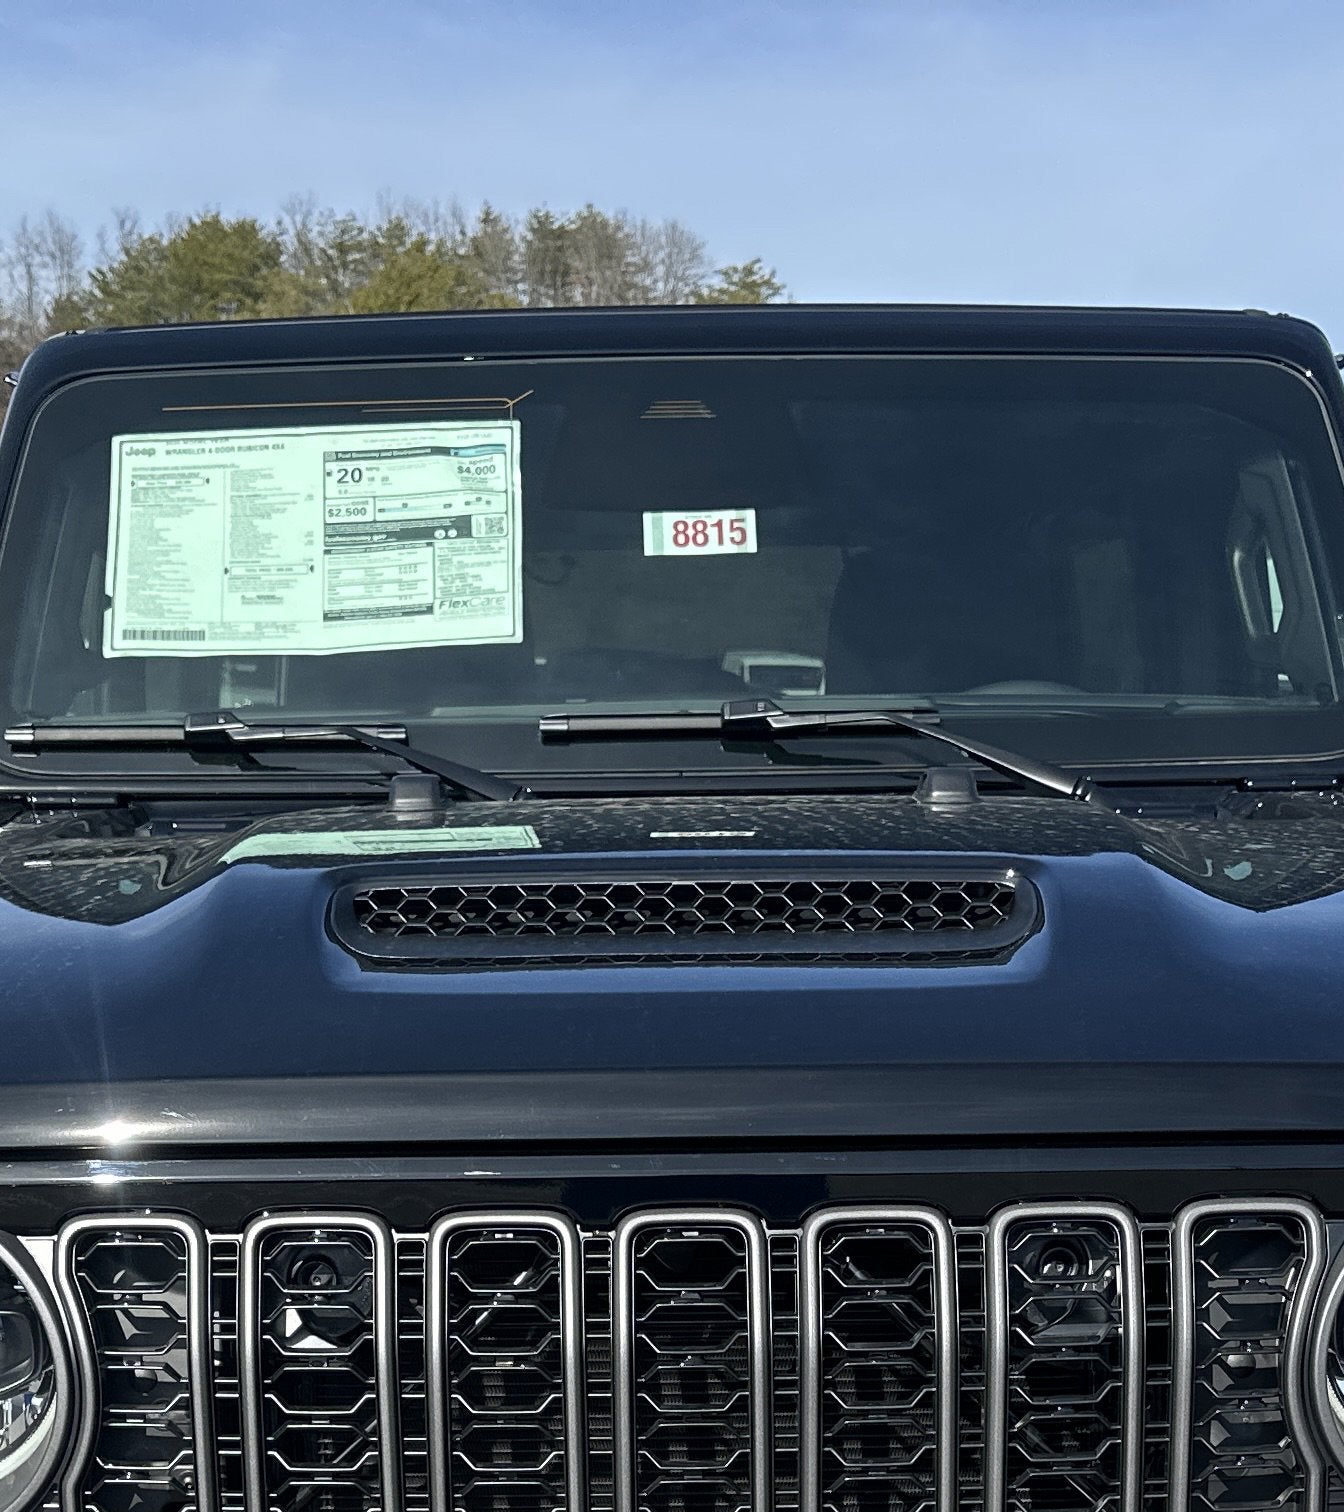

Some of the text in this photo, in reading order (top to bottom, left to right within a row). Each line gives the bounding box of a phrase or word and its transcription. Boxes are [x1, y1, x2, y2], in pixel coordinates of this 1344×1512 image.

[125, 446, 156, 458] Jeep
[165, 447, 206, 456] WRANGLER
[214, 446, 236, 454] DOOR
[237, 444, 270, 453] RUBICON
[336, 467, 363, 484] 20
[457, 464, 496, 476] $4,000
[327, 507, 367, 518] $2,500
[672, 518, 747, 547] 8815
